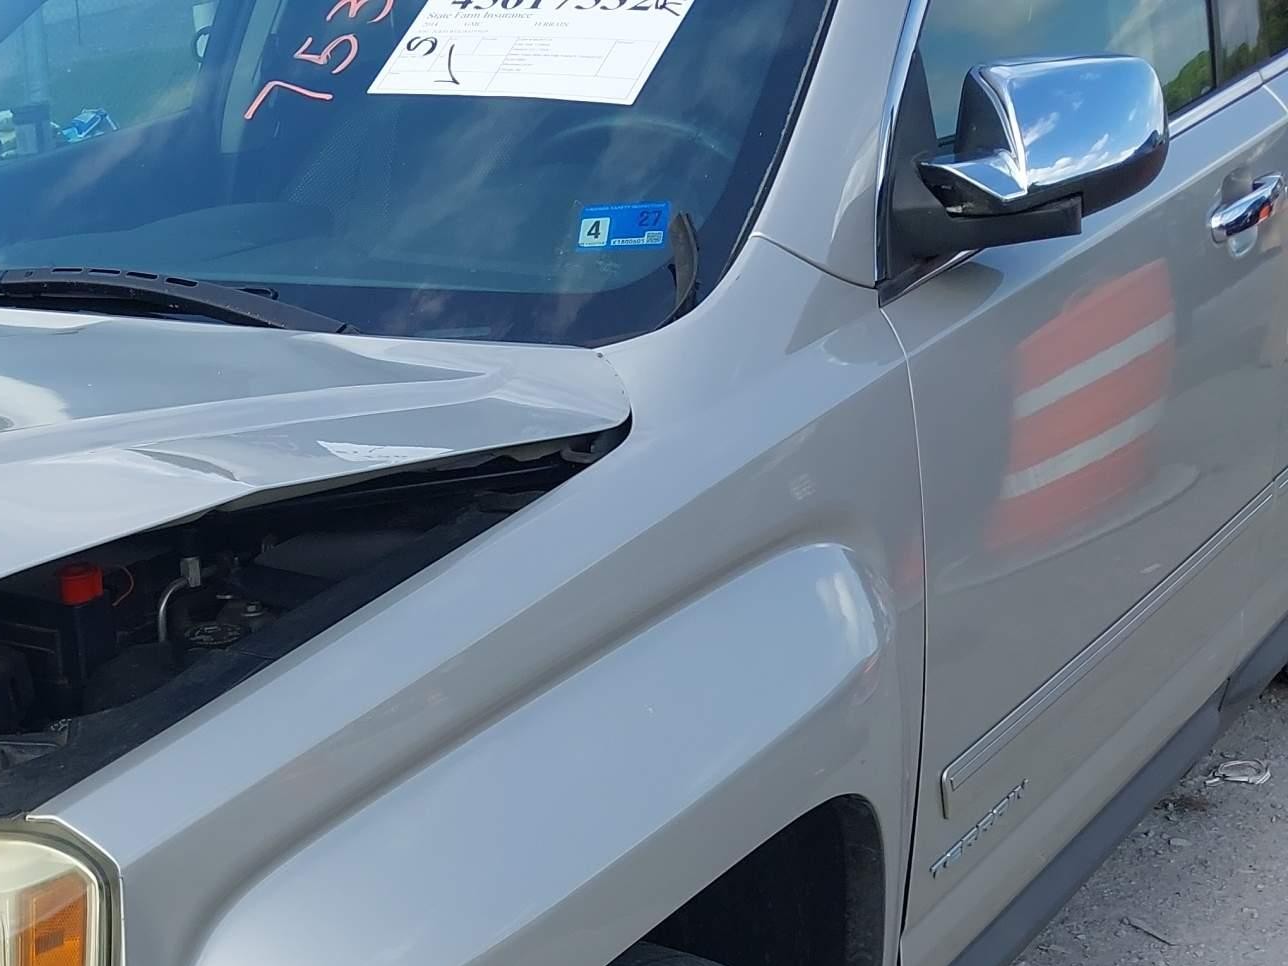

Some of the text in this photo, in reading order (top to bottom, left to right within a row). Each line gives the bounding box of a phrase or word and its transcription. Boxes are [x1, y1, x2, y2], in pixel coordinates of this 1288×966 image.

[426, 11, 533, 20] State Farm Insurance
[638, 210, 663, 227] 27
[587, 219, 601, 239] 4
[929, 778, 1029, 880] TERRAIN
